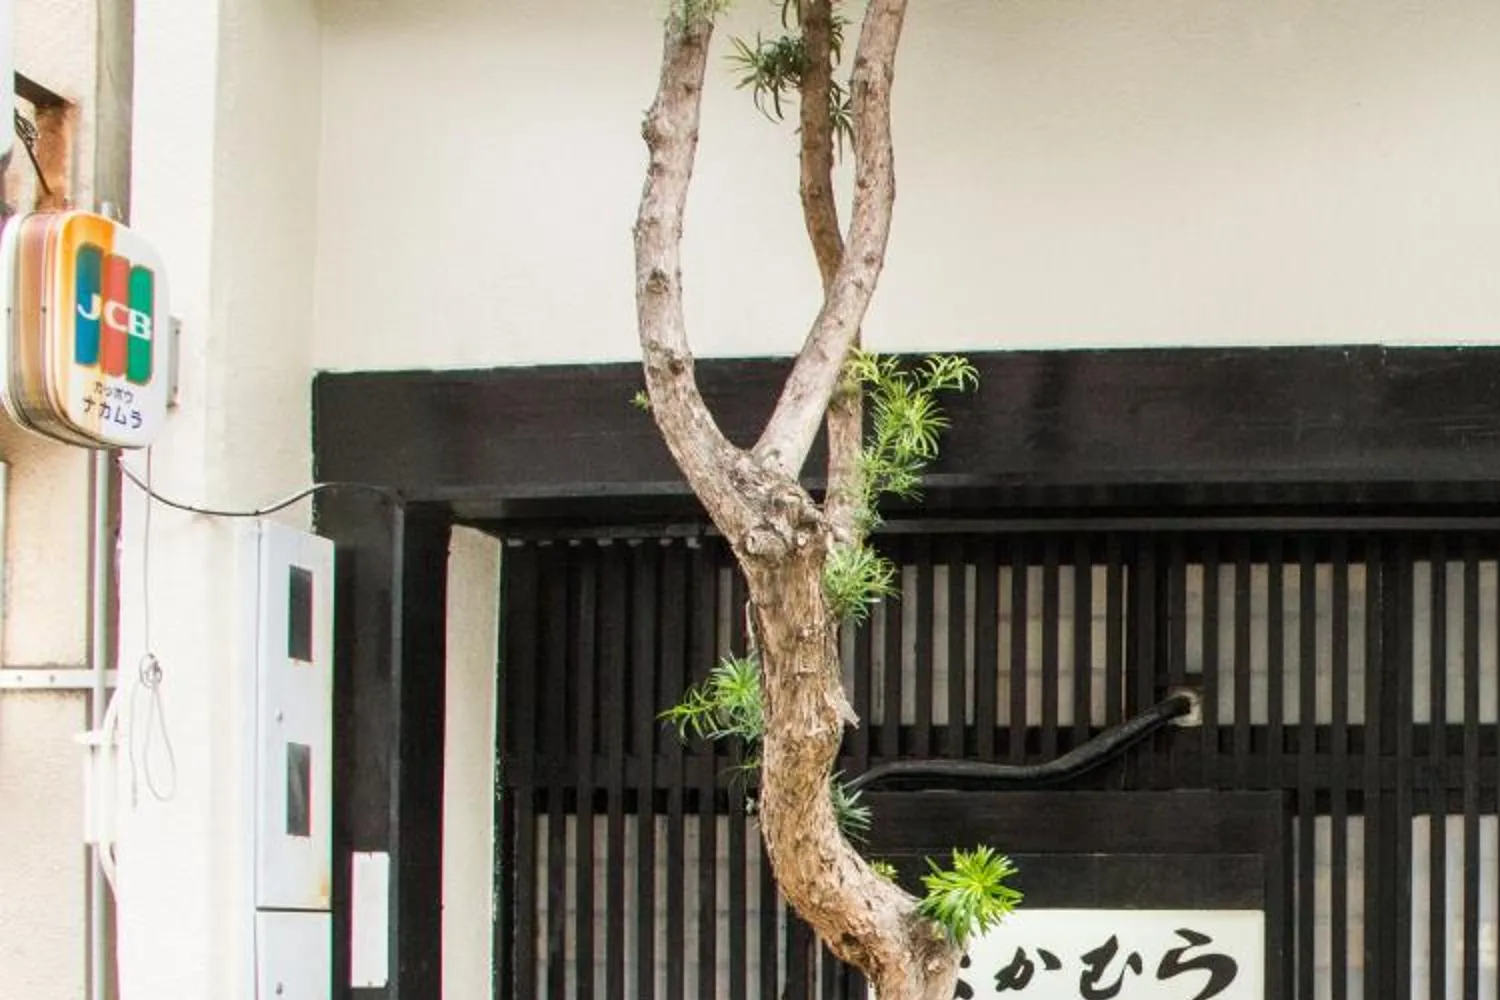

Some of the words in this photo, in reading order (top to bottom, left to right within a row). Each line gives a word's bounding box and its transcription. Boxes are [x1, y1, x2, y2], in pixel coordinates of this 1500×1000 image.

[77, 293, 152, 340] JCB
[83, 395, 143, 429] ナカムラ
